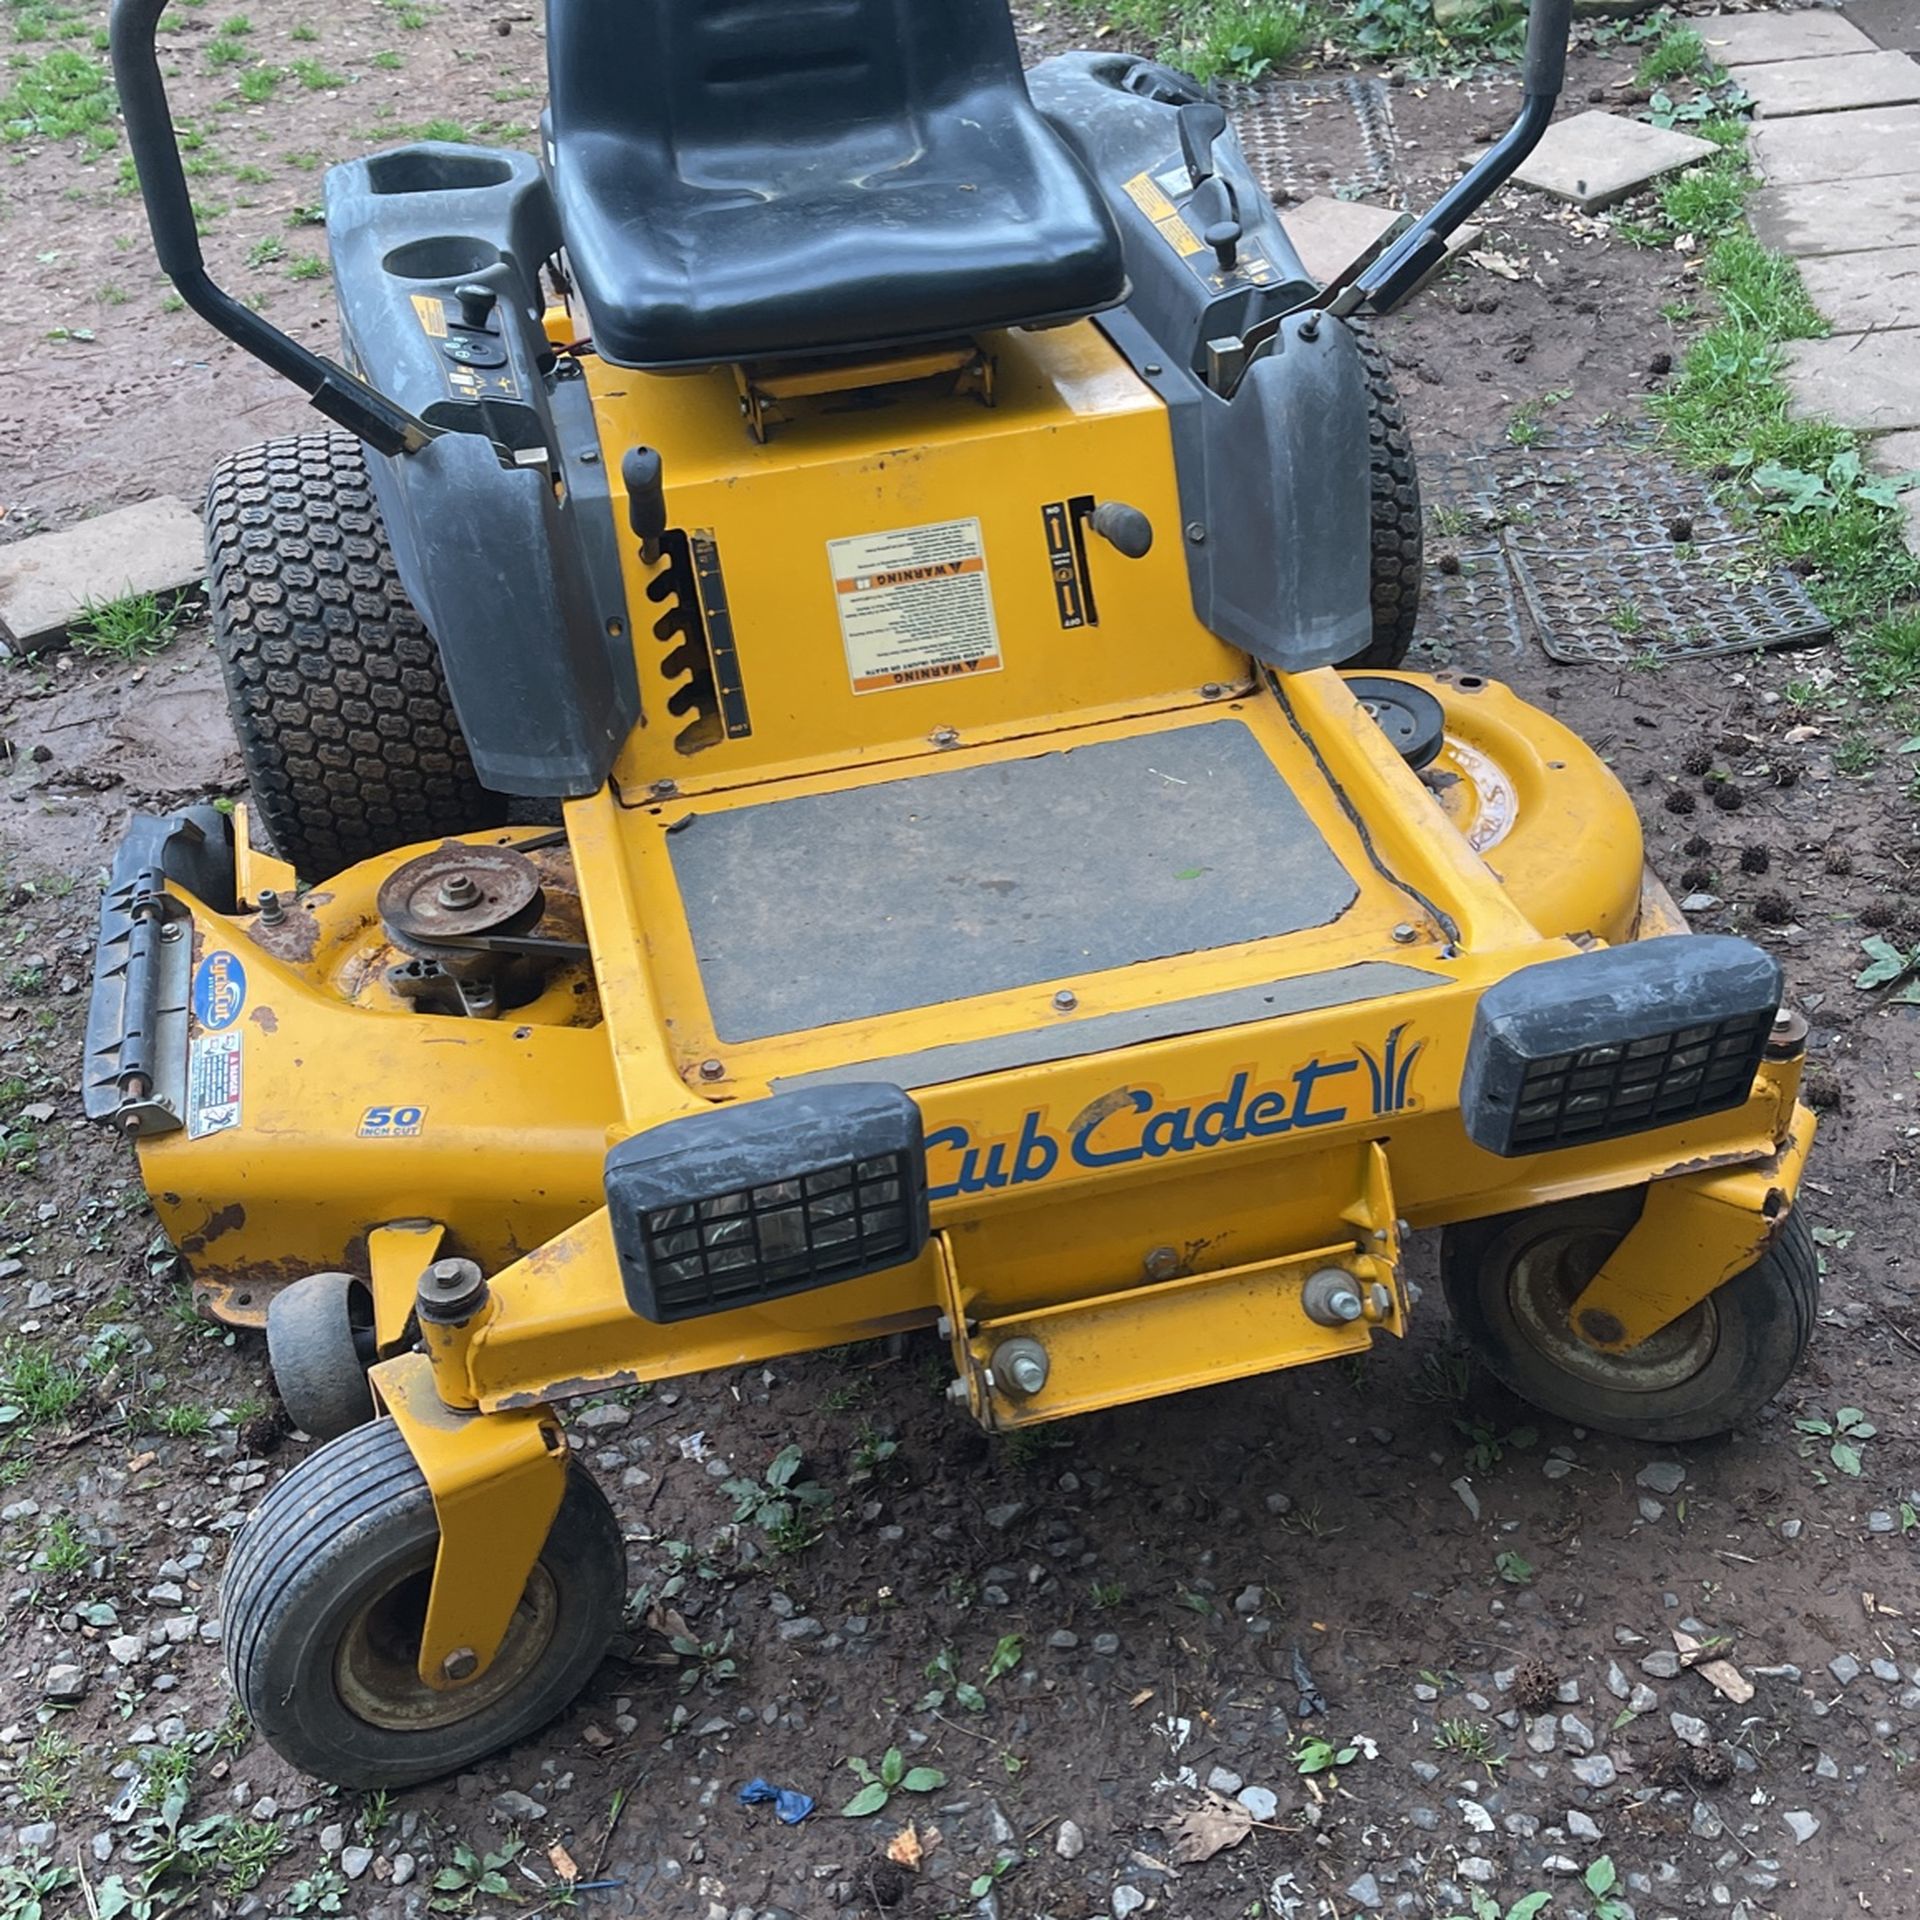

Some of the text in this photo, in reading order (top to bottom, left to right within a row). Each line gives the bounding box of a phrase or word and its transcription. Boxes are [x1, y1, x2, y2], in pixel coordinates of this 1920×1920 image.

[877, 563, 947, 585] WARNING
[893, 661, 963, 684] WARNING
[364, 1106, 422, 1128] 50
[924, 1056, 1359, 1200] Cub Cadet
[360, 1127, 418, 1136] INCH CUT
